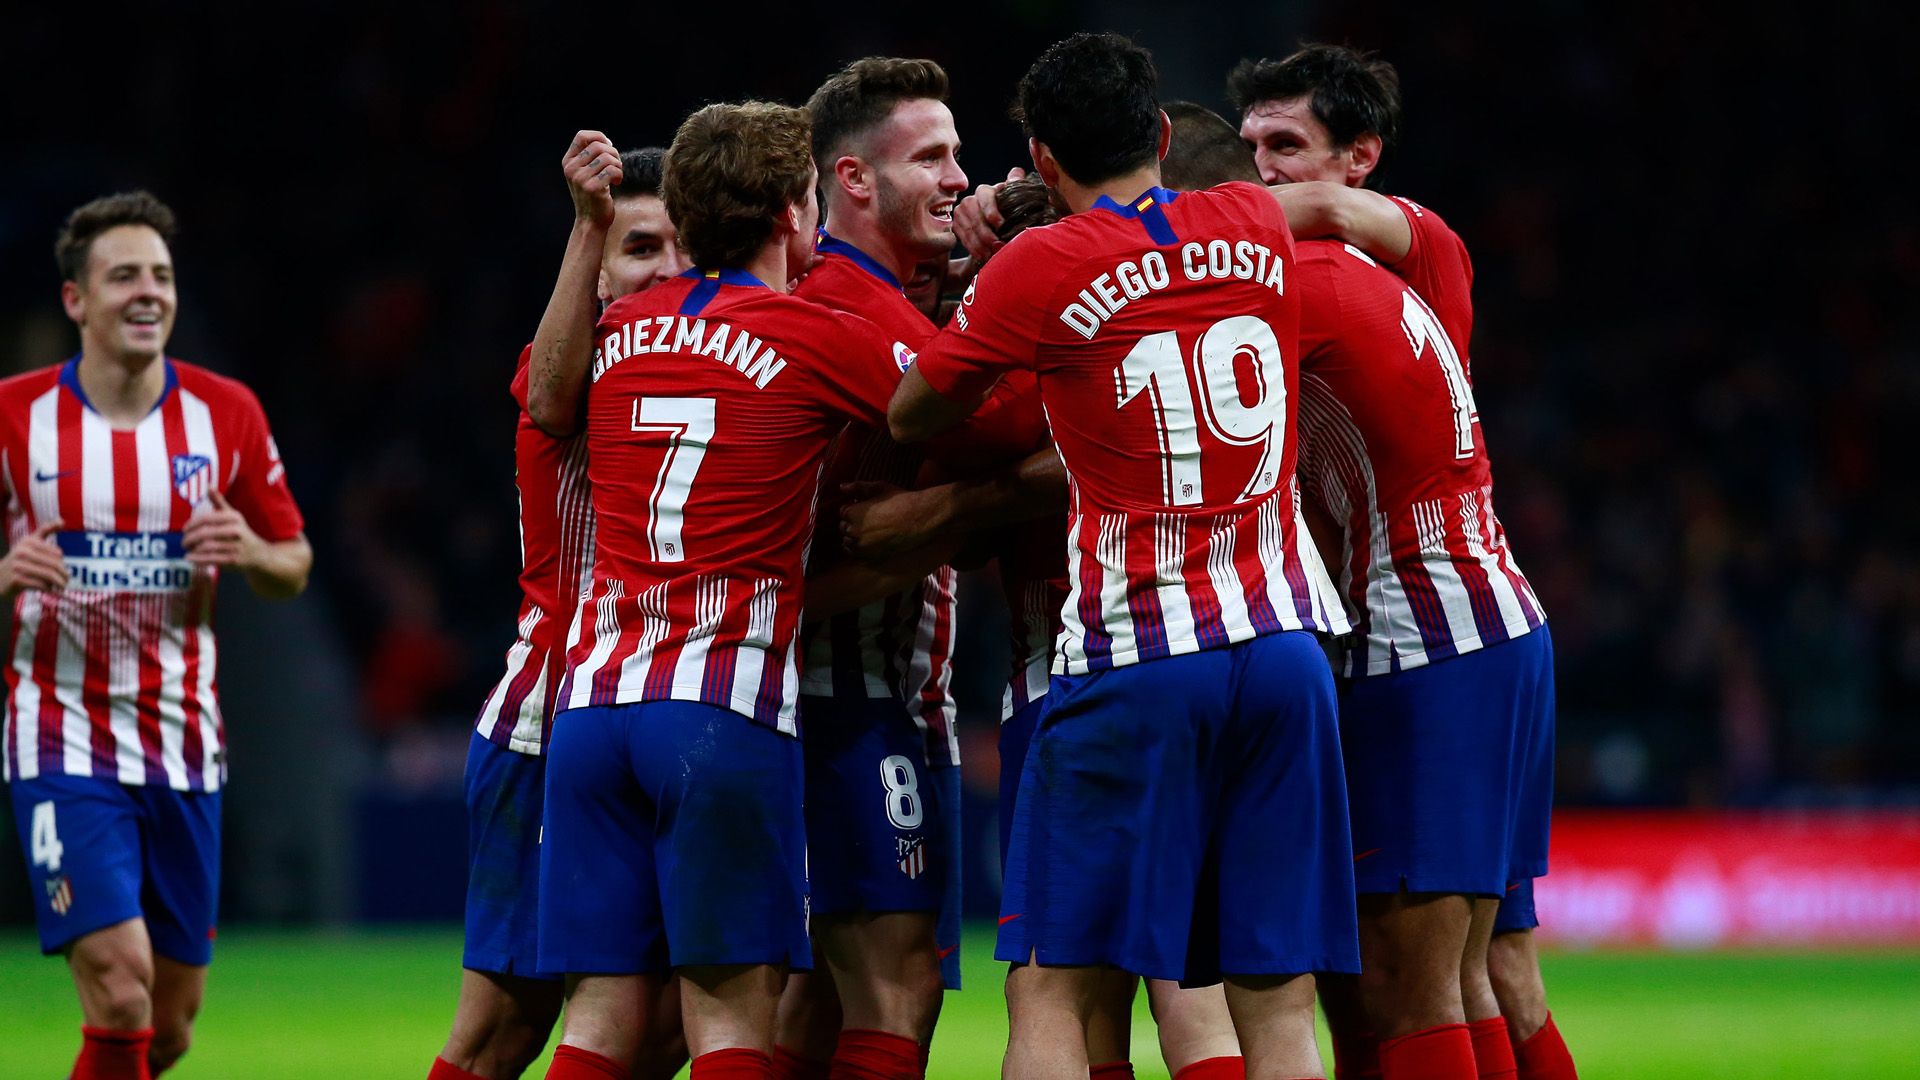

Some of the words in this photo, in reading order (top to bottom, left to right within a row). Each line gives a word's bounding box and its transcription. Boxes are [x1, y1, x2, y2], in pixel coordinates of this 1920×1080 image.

[1059, 251, 1170, 340] DIEGO
[1182, 239, 1284, 296] COSTA
[592, 316, 788, 390] GRIEZMANN
[1400, 286, 1480, 460] 1
[1113, 316, 1287, 508] 19
[631, 397, 717, 563] 7
[66, 564, 191, 588] Plus500
[86, 532, 168, 558] Trade
[880, 755, 924, 830] 8
[32, 800, 64, 870] 4
